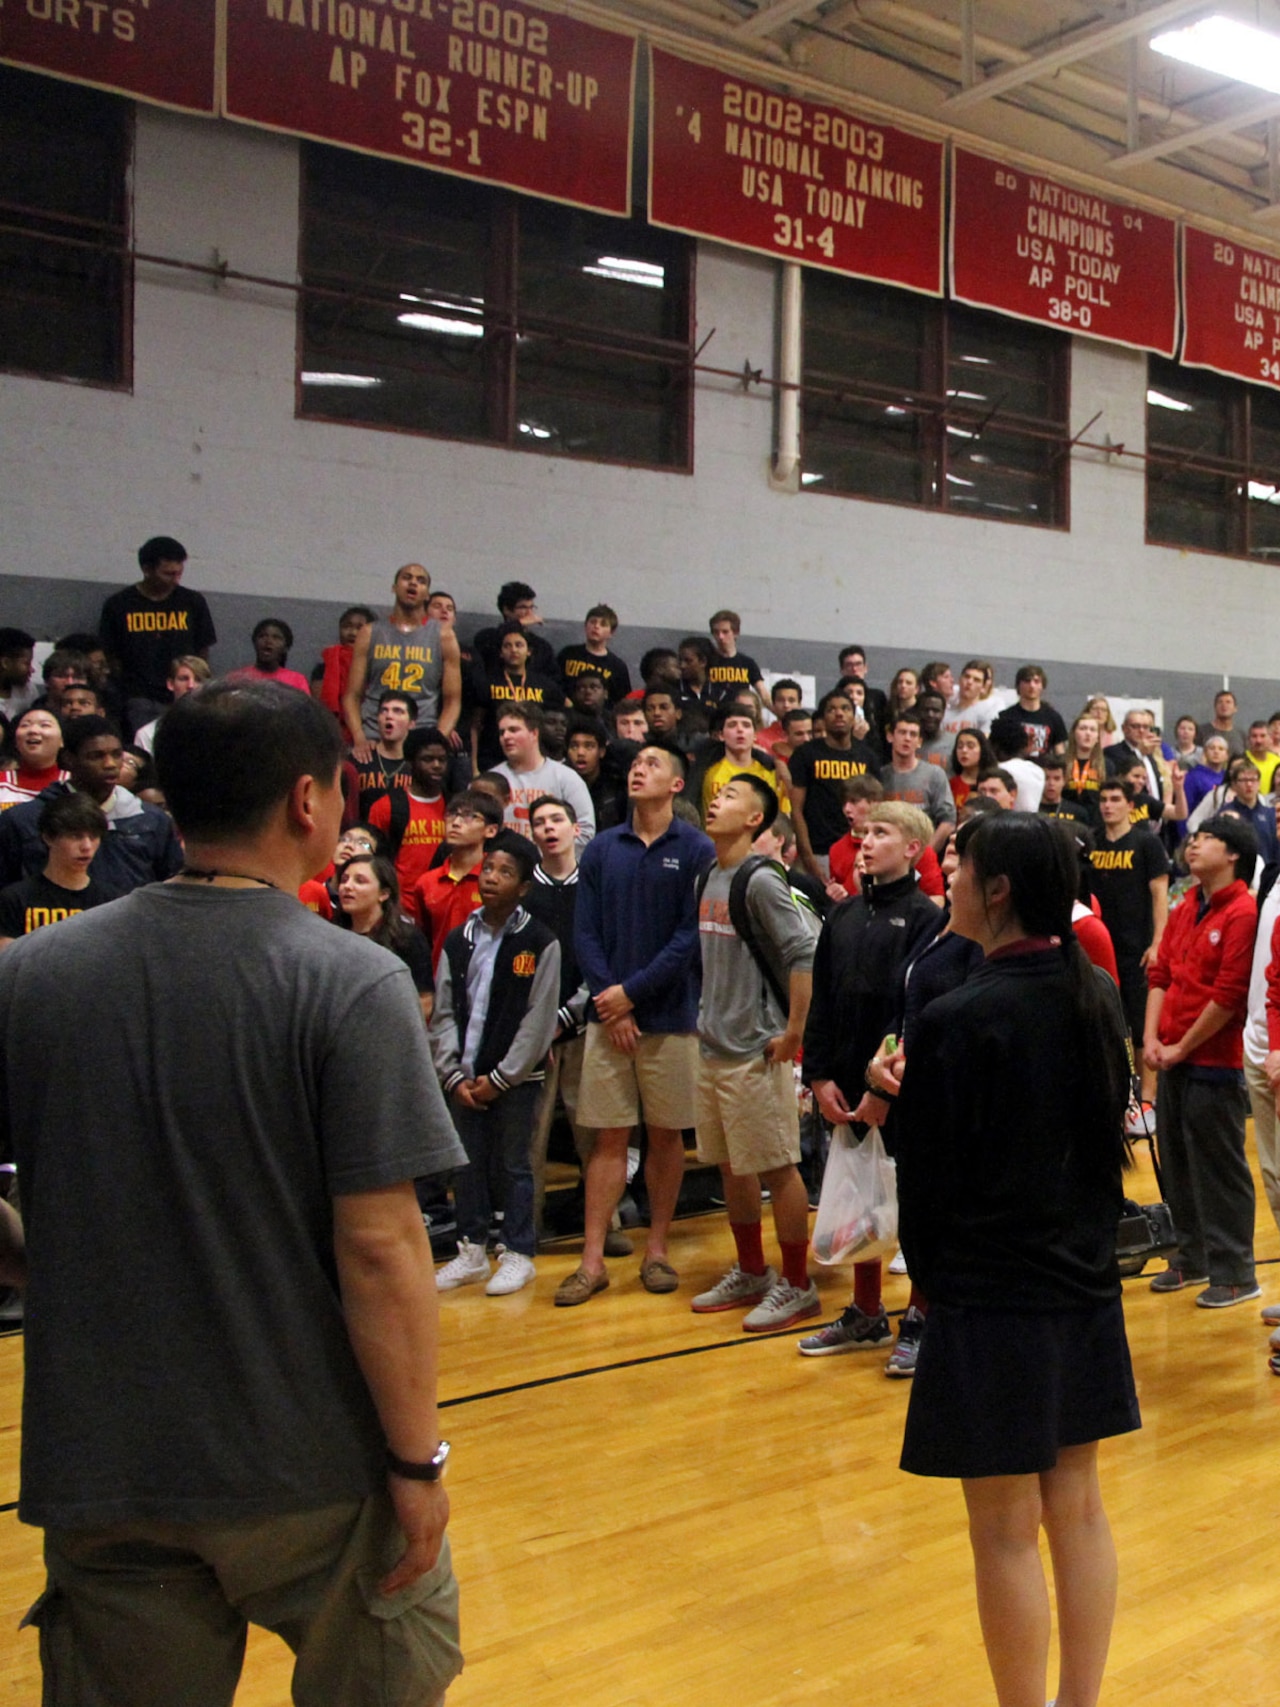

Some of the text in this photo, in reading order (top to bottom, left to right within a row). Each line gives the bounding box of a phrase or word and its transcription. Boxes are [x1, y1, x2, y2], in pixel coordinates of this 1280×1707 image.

[266, 0, 416, 59] NATIONAL
[328, 46, 547, 142] AP FOX ESPN
[448, 34, 599, 111] RUNNER-UP
[402, 111, 482, 165] 32-1
[723, 82, 884, 162] 2002-2003
[725, 121, 923, 210] NATIONAL RANKING
[741, 164, 866, 229] USA TODAY
[1029, 179, 1112, 227] NATIONAL
[1122, 214, 1143, 232] 04
[773, 212, 835, 259] 31-4
[1027, 205, 1115, 258] CHAMPIONS
[1016, 234, 1121, 285] USA TODAY
[1028, 265, 1111, 307] AP POLL
[1048, 296, 1092, 328] 38-0
[1234, 302, 1264, 330] USA
[1243, 329, 1264, 351] AP
[374, 644, 433, 663] OAK HILL
[381, 661, 425, 693] 42
